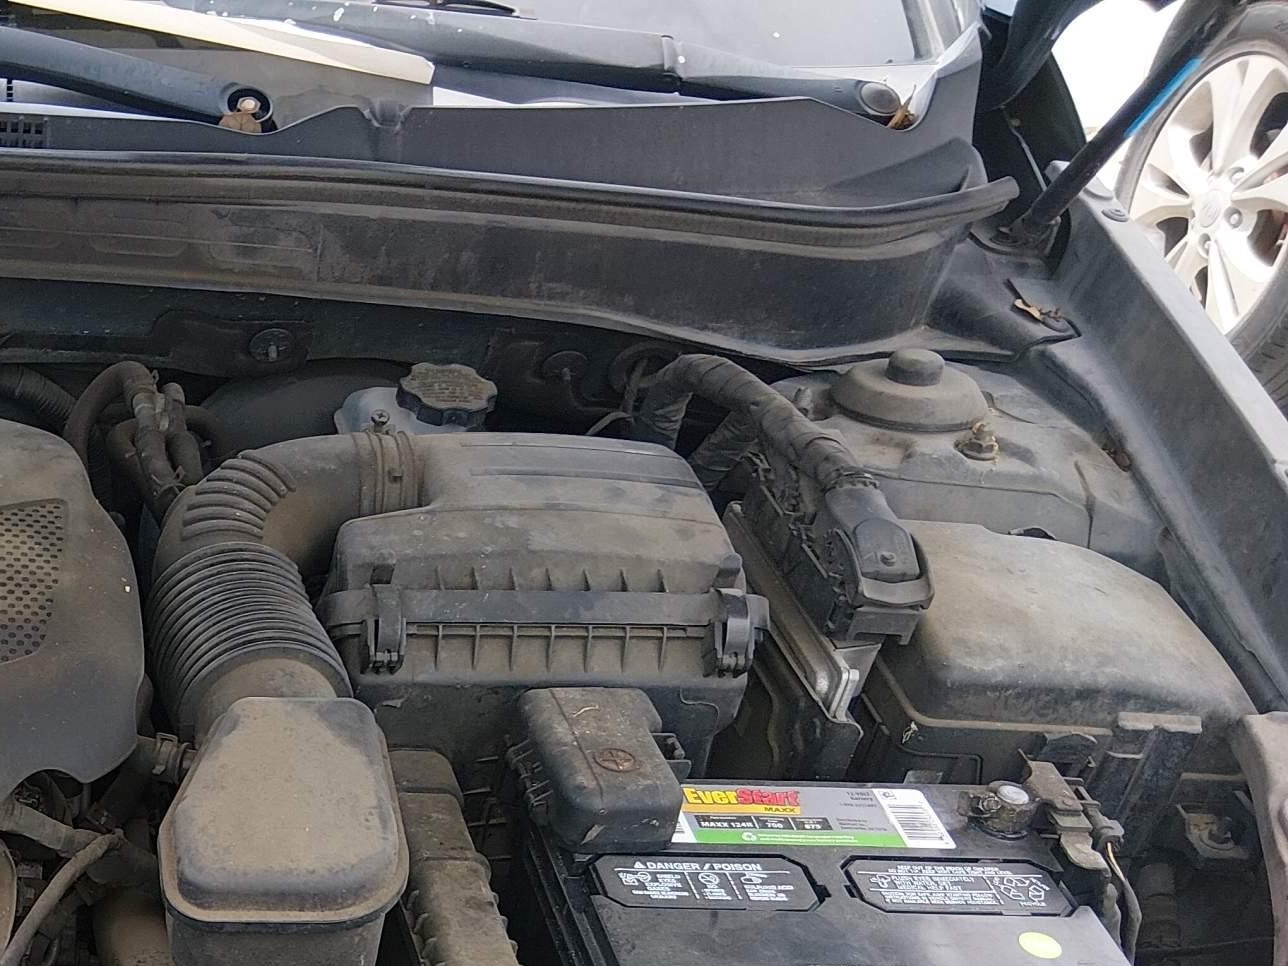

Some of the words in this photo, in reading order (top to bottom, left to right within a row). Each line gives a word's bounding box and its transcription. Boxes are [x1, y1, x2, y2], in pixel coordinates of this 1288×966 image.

[682, 787, 800, 806] EverStart
[646, 861, 701, 870] DANGER
[713, 863, 762, 871] POISON
